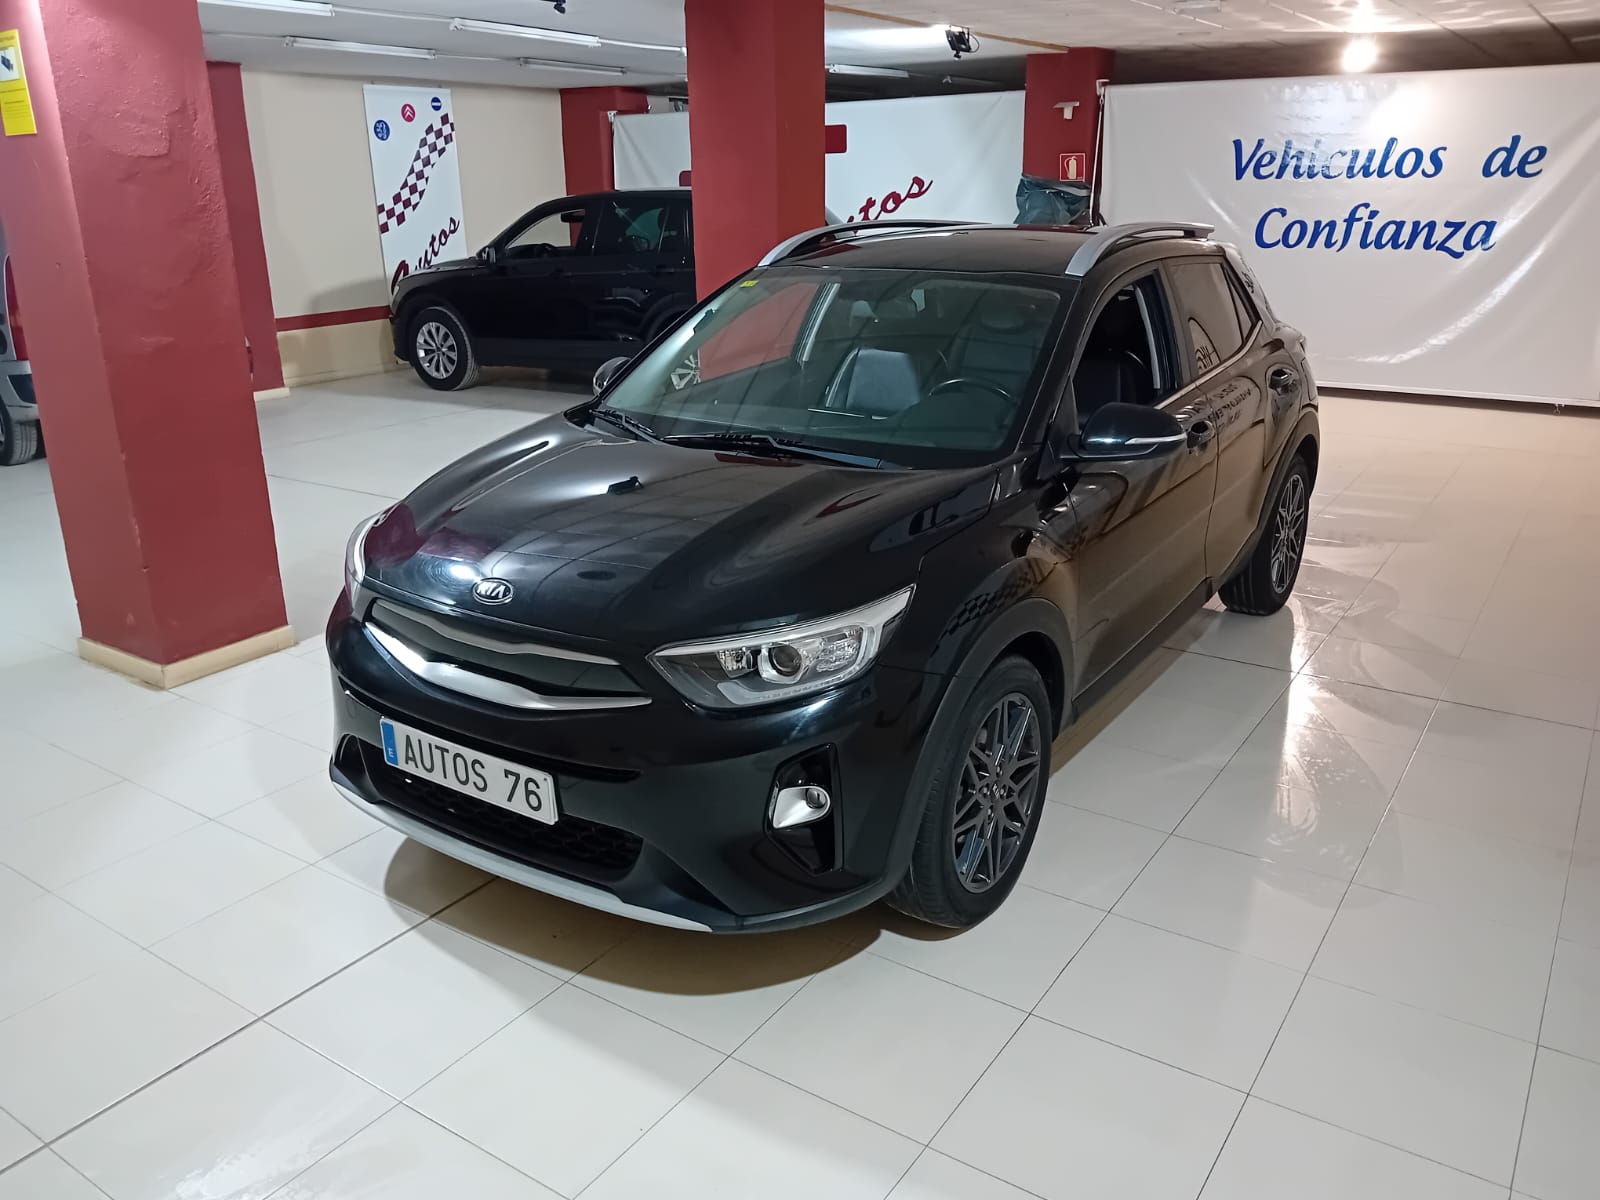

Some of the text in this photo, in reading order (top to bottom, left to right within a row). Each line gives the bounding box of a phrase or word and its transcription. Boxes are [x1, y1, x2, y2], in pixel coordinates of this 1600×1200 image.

[1482, 134, 1547, 178] de
[1254, 202, 1498, 259] Confianza
[476, 581, 506, 599] KIA
[405, 734, 542, 812] AUTOS 76
